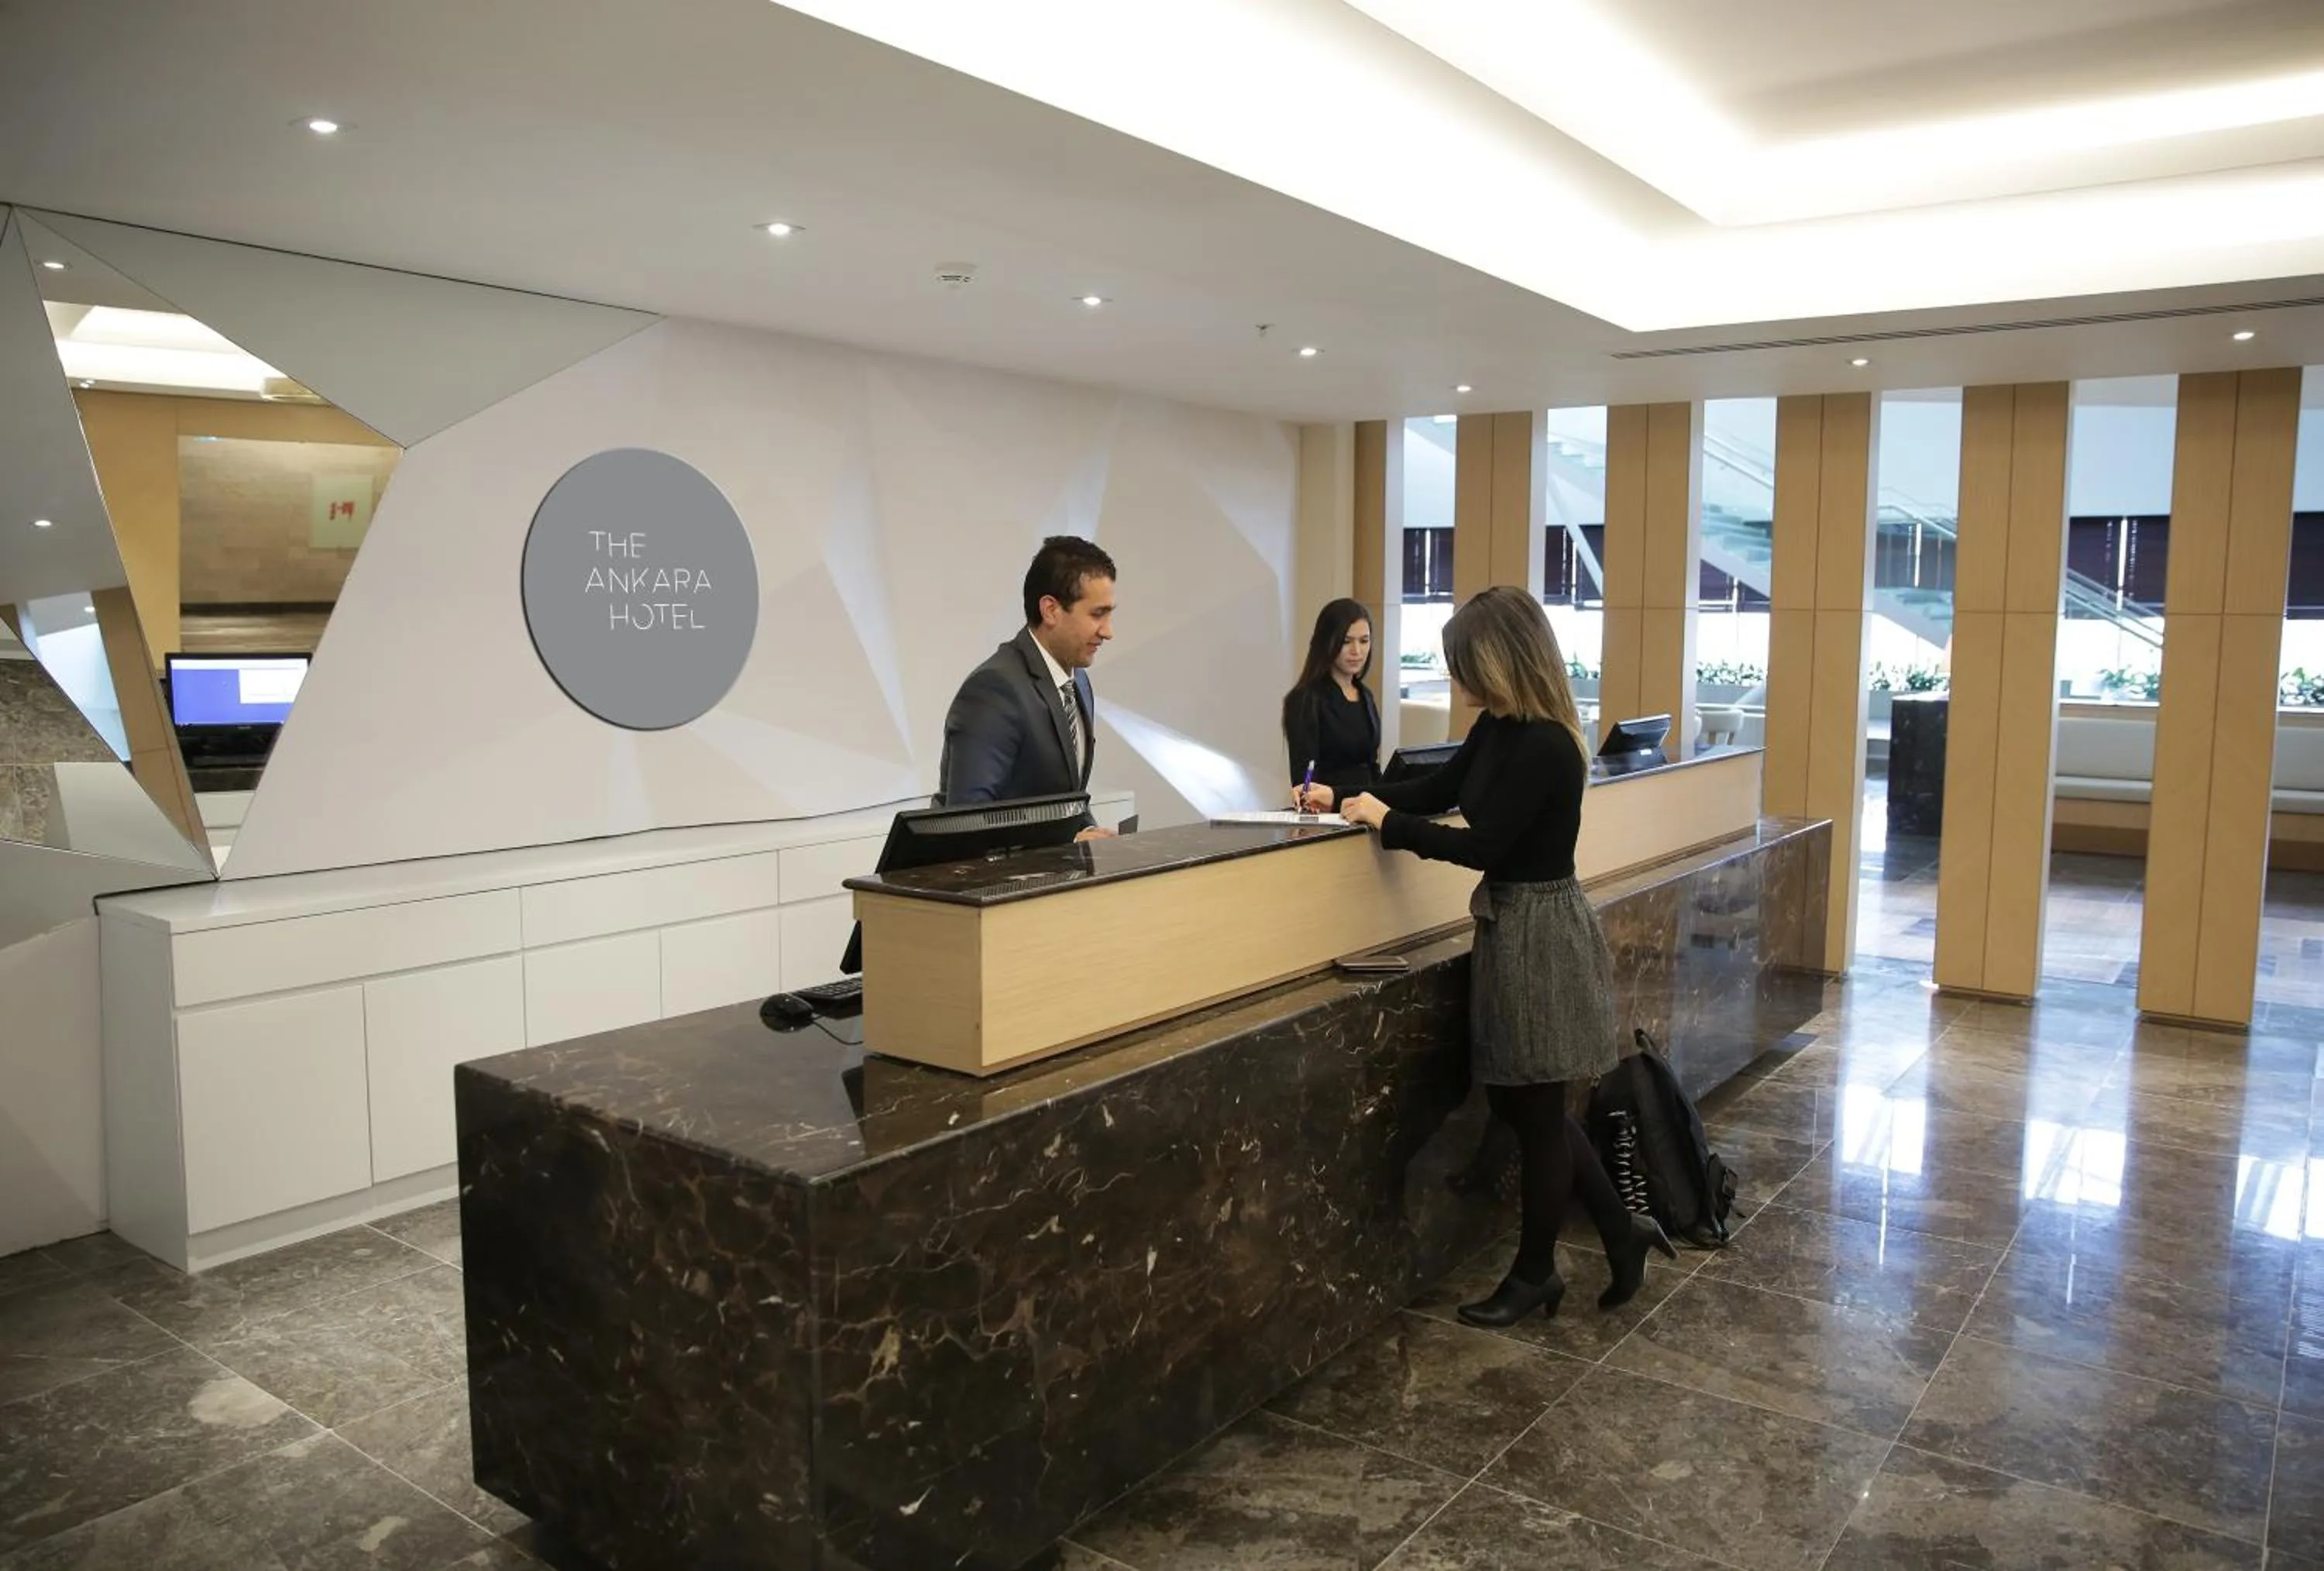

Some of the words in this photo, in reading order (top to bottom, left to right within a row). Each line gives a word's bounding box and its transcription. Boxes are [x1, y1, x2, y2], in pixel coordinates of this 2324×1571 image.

[588, 530, 647, 559] THE
[584, 566, 712, 594] ANKARA
[609, 602, 706, 631] HOTEL
